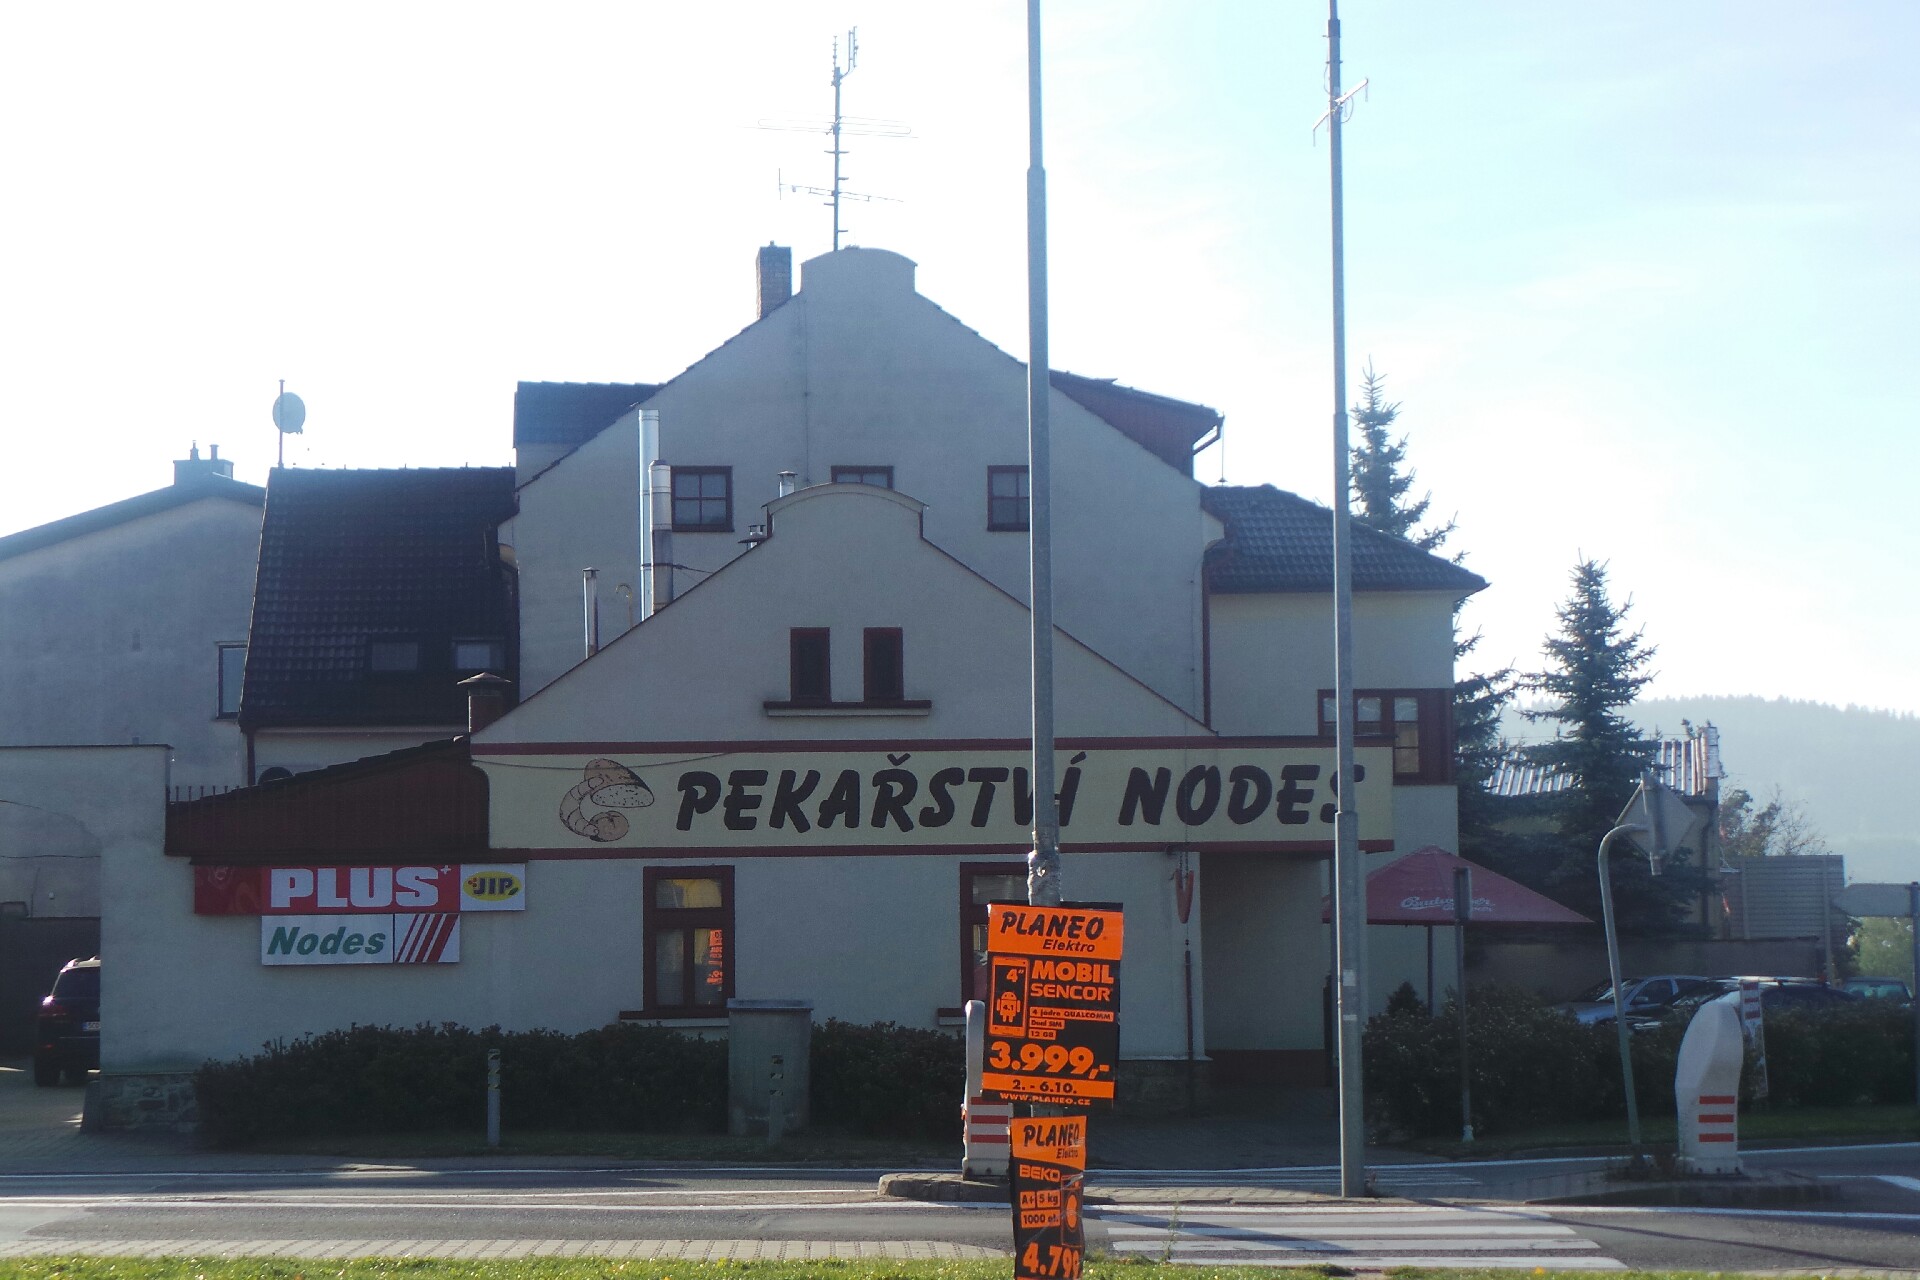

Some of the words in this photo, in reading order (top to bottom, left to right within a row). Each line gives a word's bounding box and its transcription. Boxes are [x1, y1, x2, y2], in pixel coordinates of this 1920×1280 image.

[676, 751, 1086, 833] PEKAŘSTVÍ
[1118, 764, 1365, 826] NODES
[473, 877, 513, 895] JIP
[1000, 911, 1105, 940] PLANEO
[266, 926, 387, 956] Nodes
[1043, 939, 1095, 953] Elektro
[1031, 960, 1115, 985] MOBIL
[1030, 983, 1111, 1002] SENCOR
[1064, 1010, 1111, 1020] QUALCOMM
[989, 1041, 1110, 1079] 3.999,-
[1012, 1079, 1026, 1090] 2.
[1040, 1081, 1077, 1094] 6.10.
[1000, 1092, 1091, 1106] WWW.PLANEO.CZ
[1023, 1123, 1080, 1147] PLANEO
[1019, 1164, 1061, 1183] BEKO
[1022, 1195, 1034, 1204] A+
[1039, 1194, 1045, 1203] 5
[1048, 1193, 1058, 1206] kg
[1023, 1214, 1046, 1224] 1000
